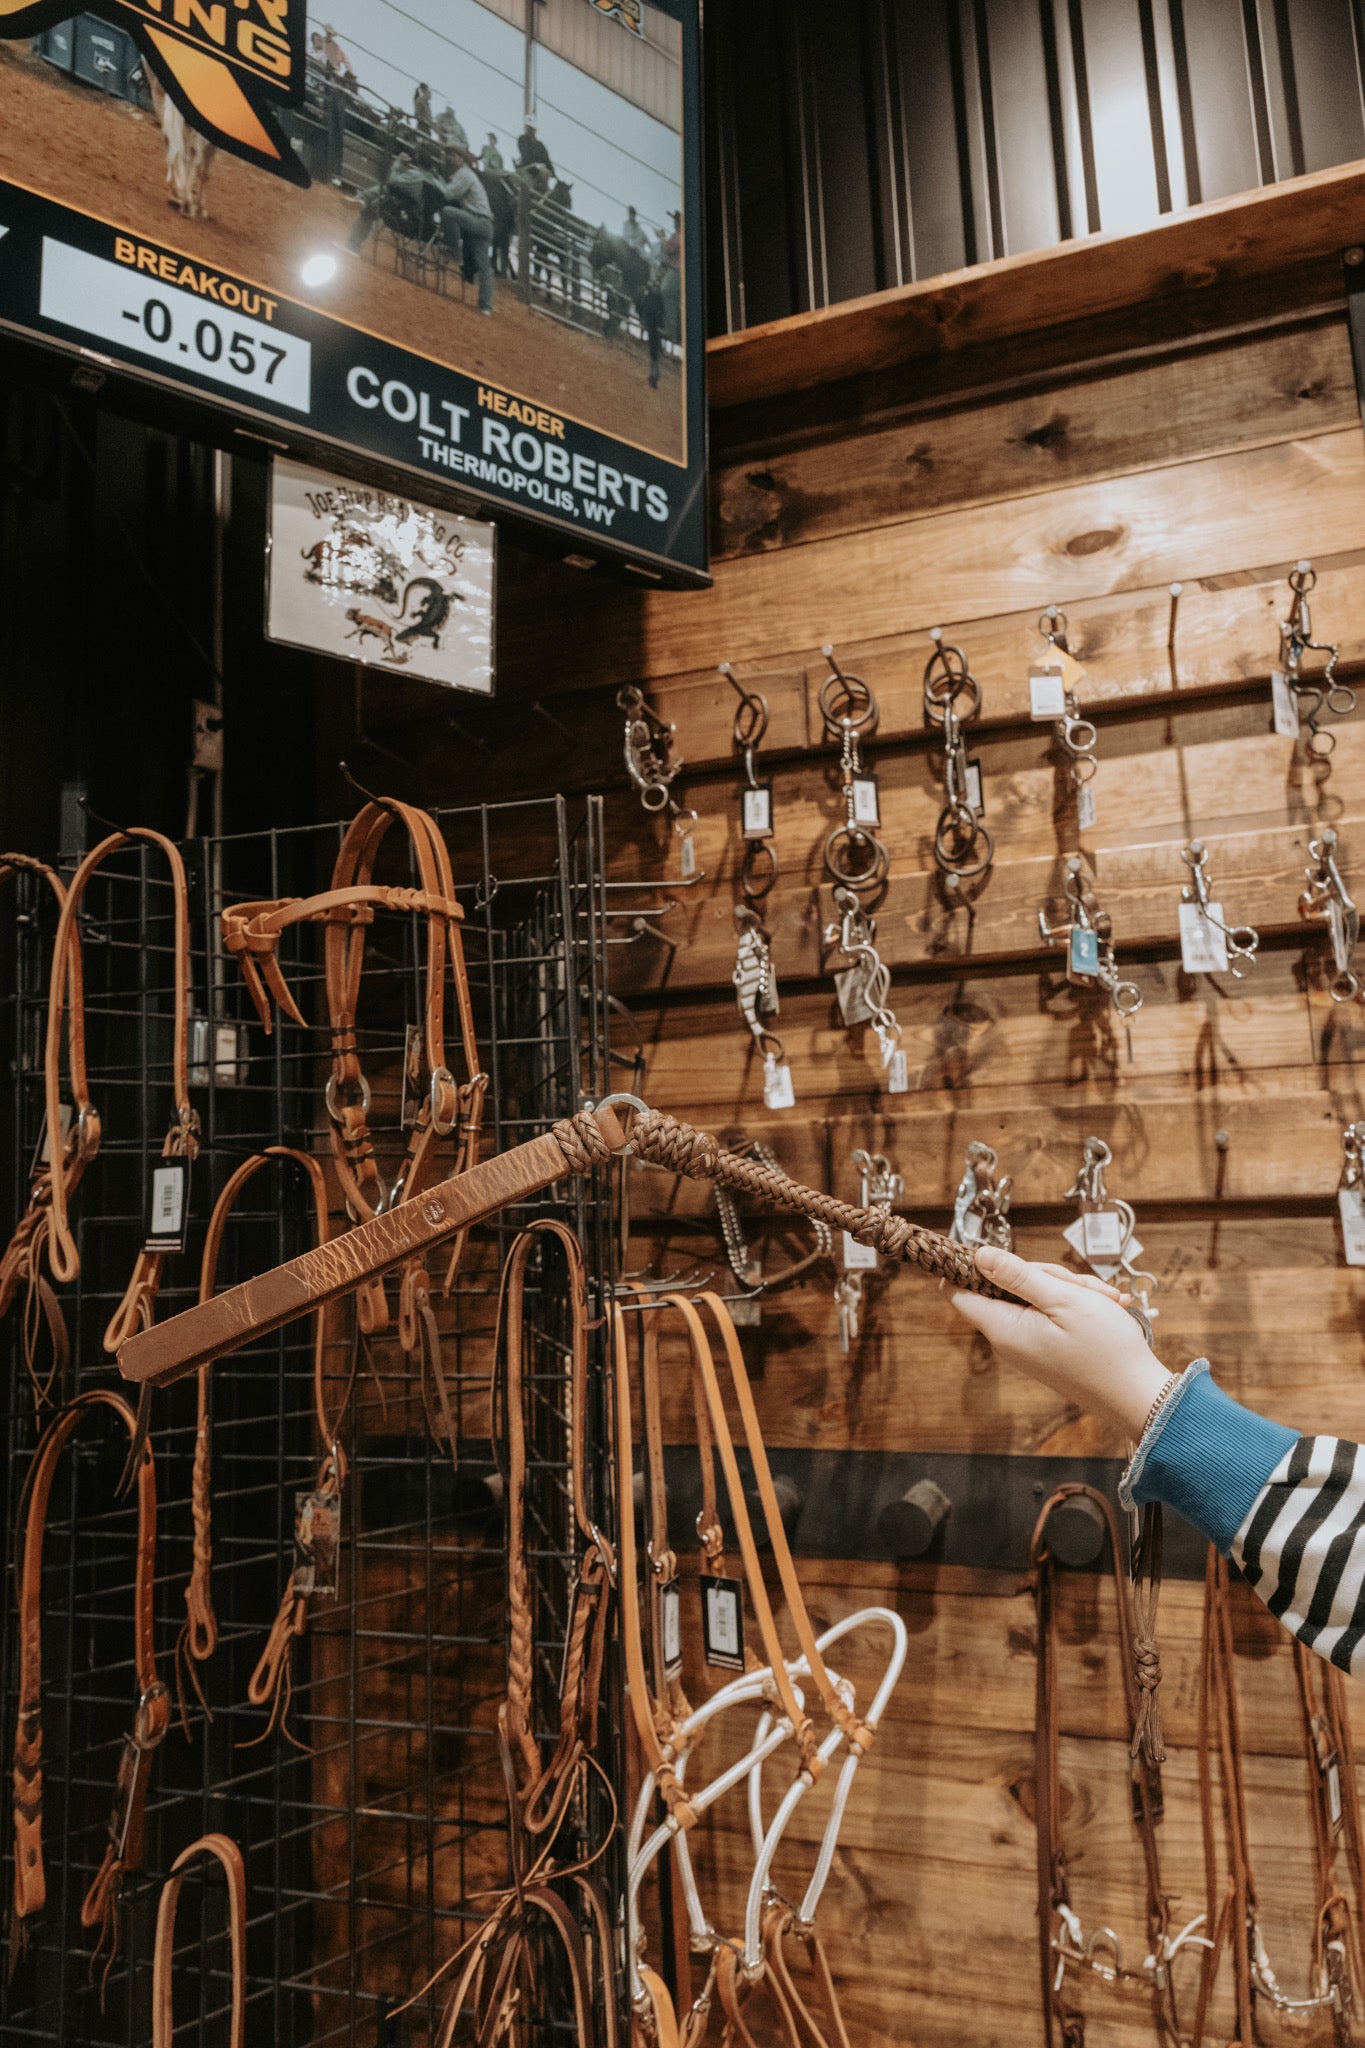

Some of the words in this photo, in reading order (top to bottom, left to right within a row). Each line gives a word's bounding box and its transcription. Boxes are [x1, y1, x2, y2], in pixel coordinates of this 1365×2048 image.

[114, 236, 278, 321] BREAKOUT
[122, 299, 287, 385] -0.057
[346, 366, 470, 443] COLT
[482, 416, 670, 522] ROBERTS
[477, 386, 565, 440] HEADER
[417, 436, 580, 518] THERMOPOLIS,
[583, 499, 616, 527] WY
